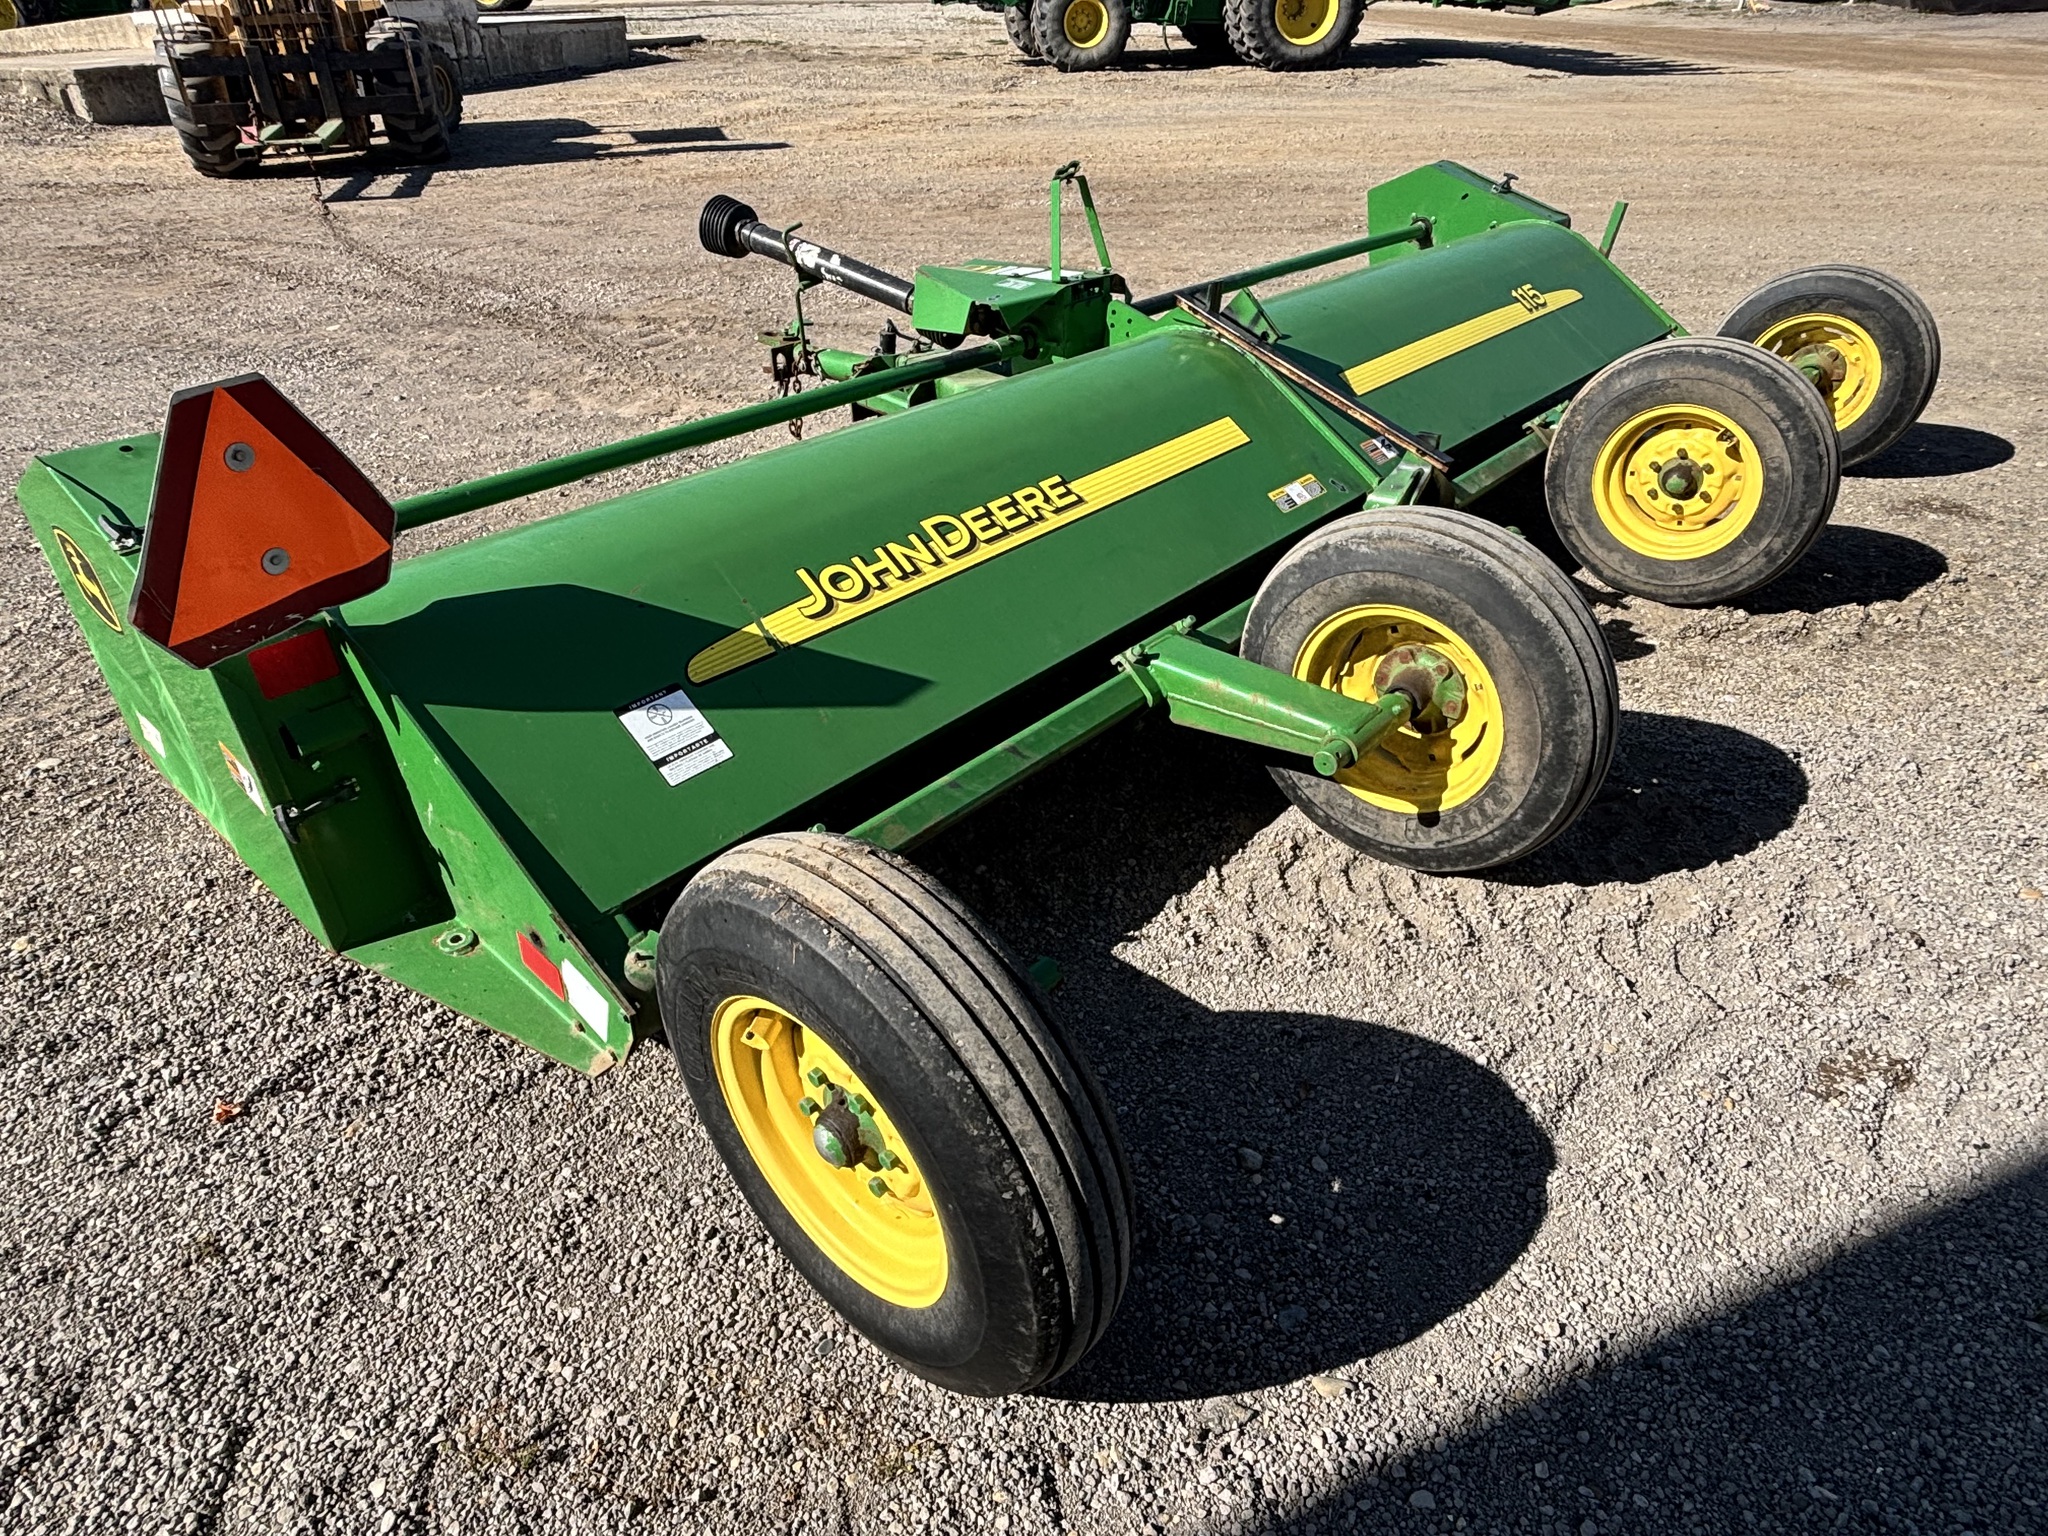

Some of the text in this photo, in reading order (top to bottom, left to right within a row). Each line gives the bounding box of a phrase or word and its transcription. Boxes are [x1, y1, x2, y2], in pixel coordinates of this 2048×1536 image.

[1511, 283, 1547, 312] 115
[795, 474, 1086, 619] JOHN DEERE
[628, 690, 667, 710] IMPORTANT
[665, 738, 709, 762] IMPORTANTE
